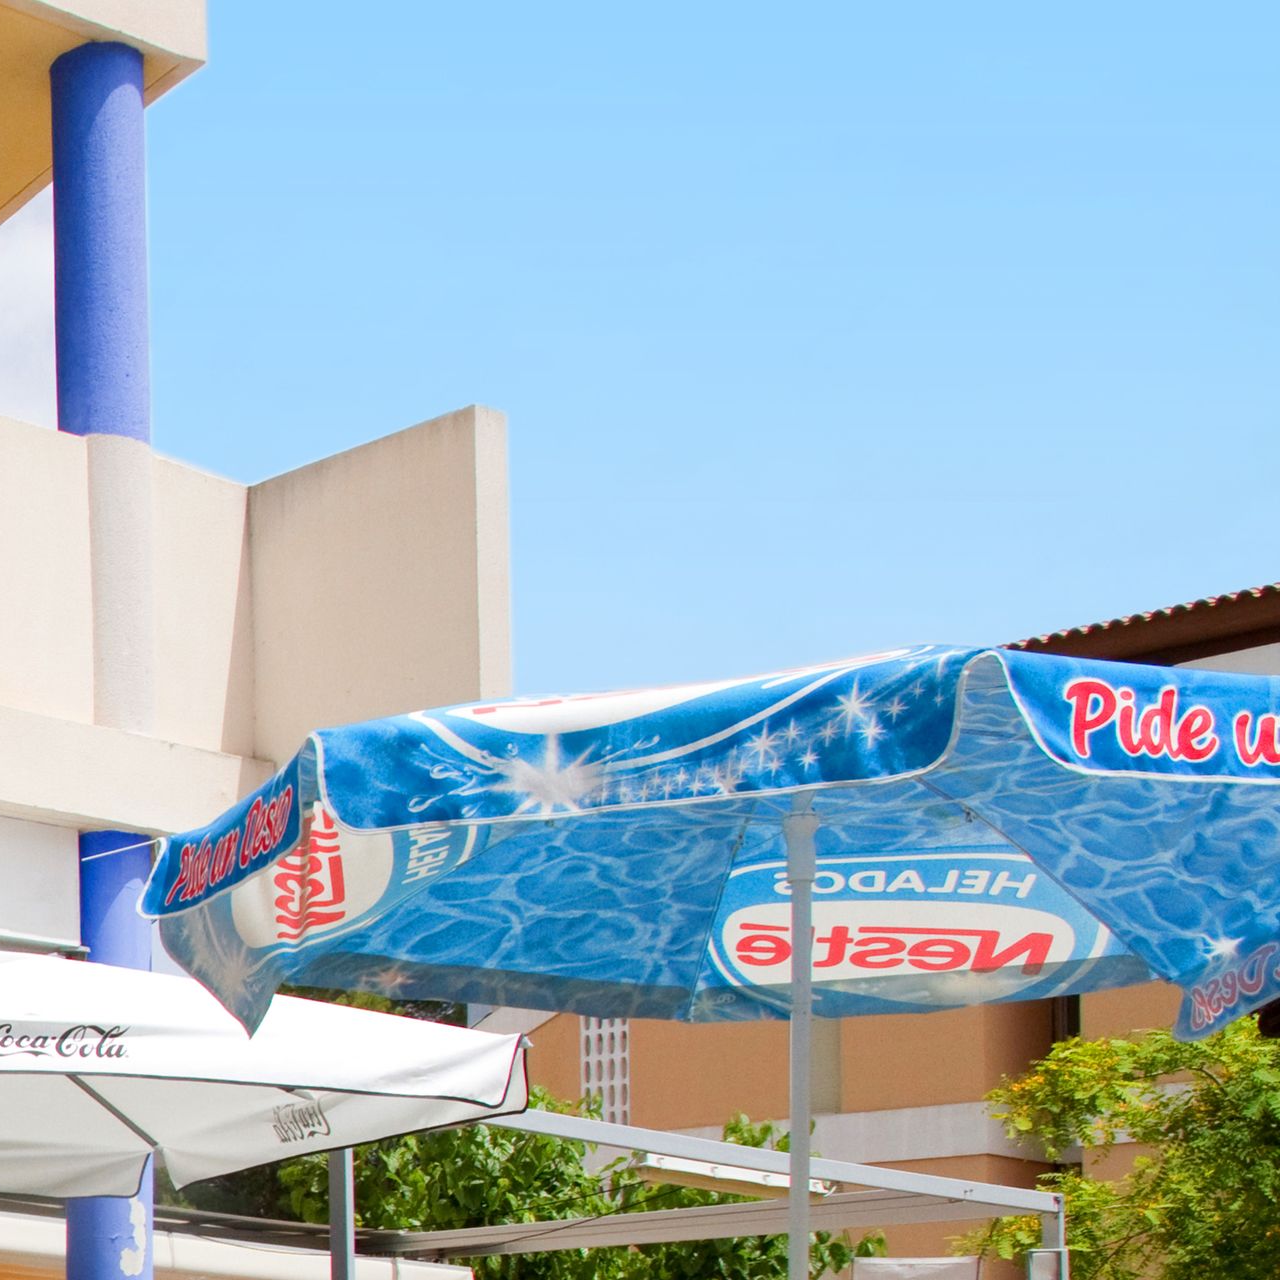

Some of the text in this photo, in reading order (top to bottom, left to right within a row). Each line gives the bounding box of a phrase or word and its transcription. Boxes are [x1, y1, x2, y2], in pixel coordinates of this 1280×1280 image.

[1064, 677, 1280, 767] Pide u
[165, 833, 213, 905] Pide
[209, 827, 241, 884] un
